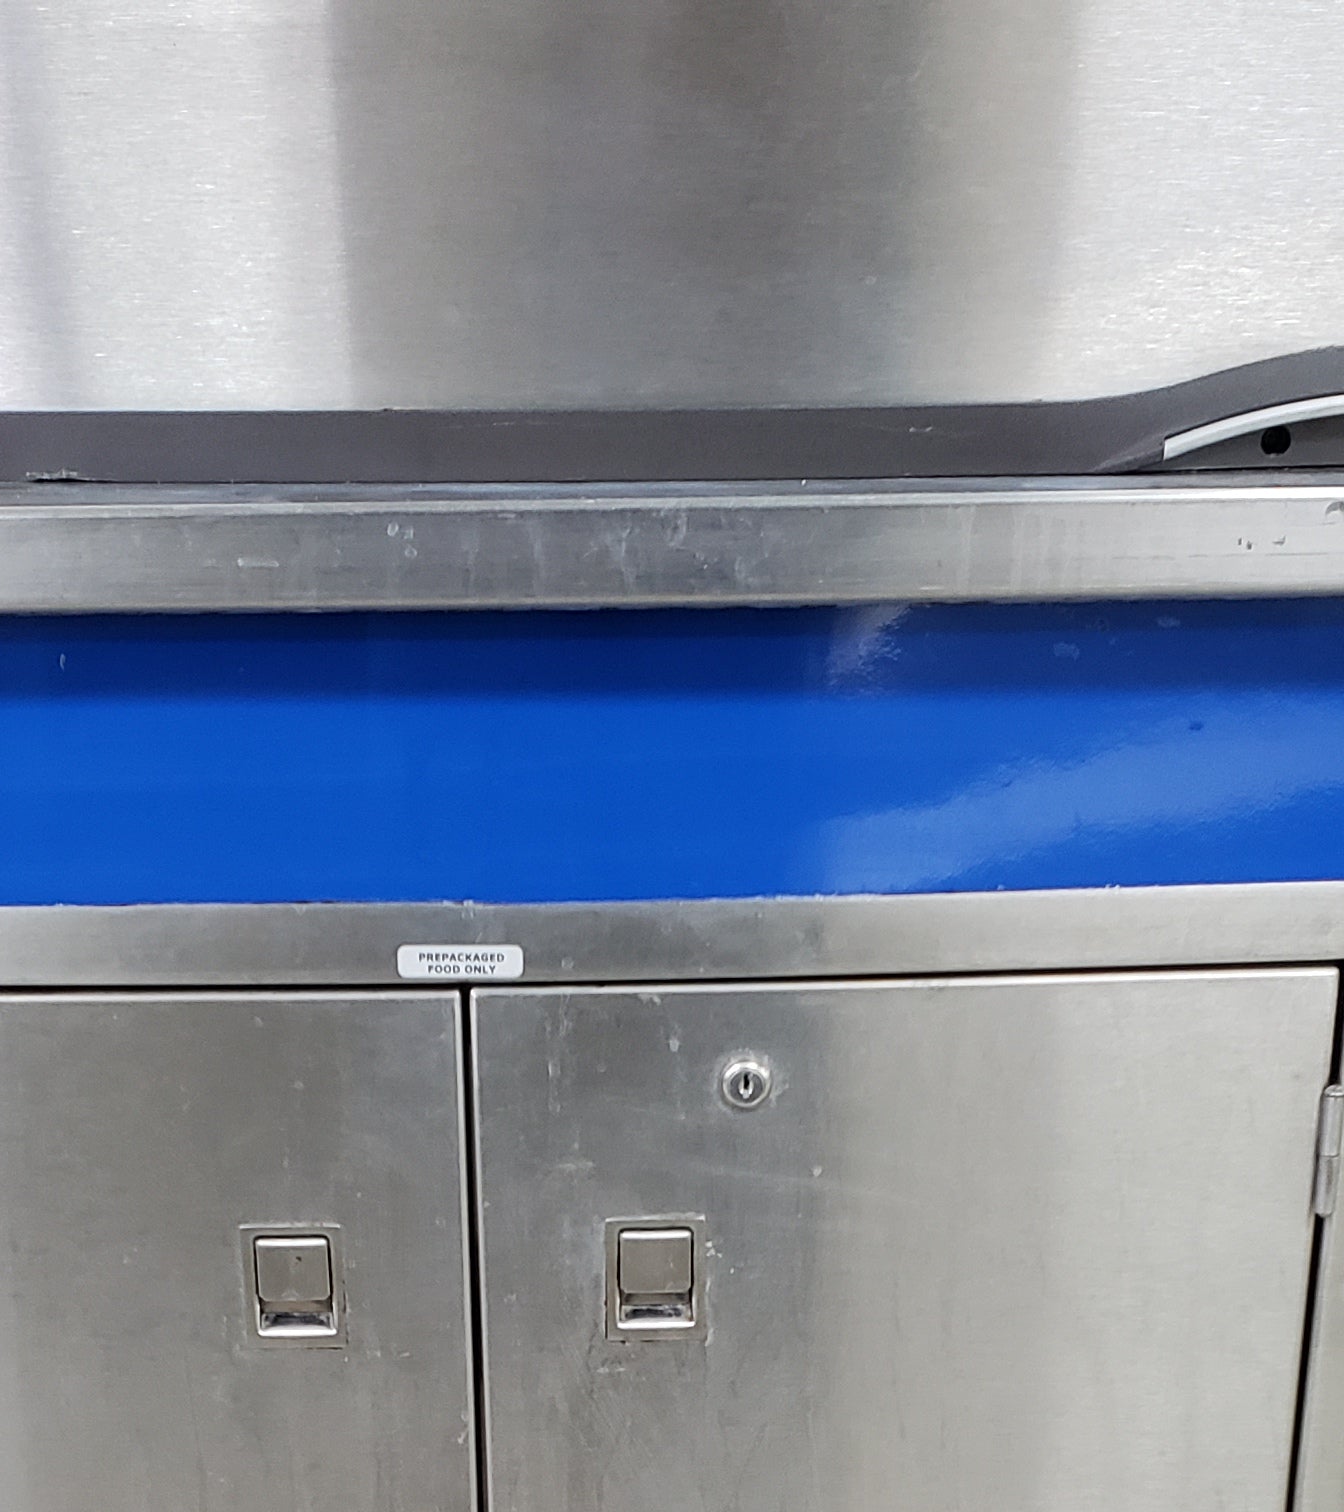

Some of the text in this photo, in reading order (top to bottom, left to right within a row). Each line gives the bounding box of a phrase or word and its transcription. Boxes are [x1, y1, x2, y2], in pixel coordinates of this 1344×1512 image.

[418, 952, 505, 963] PREPACKAGED
[428, 965, 496, 974] FOOD ONLY
